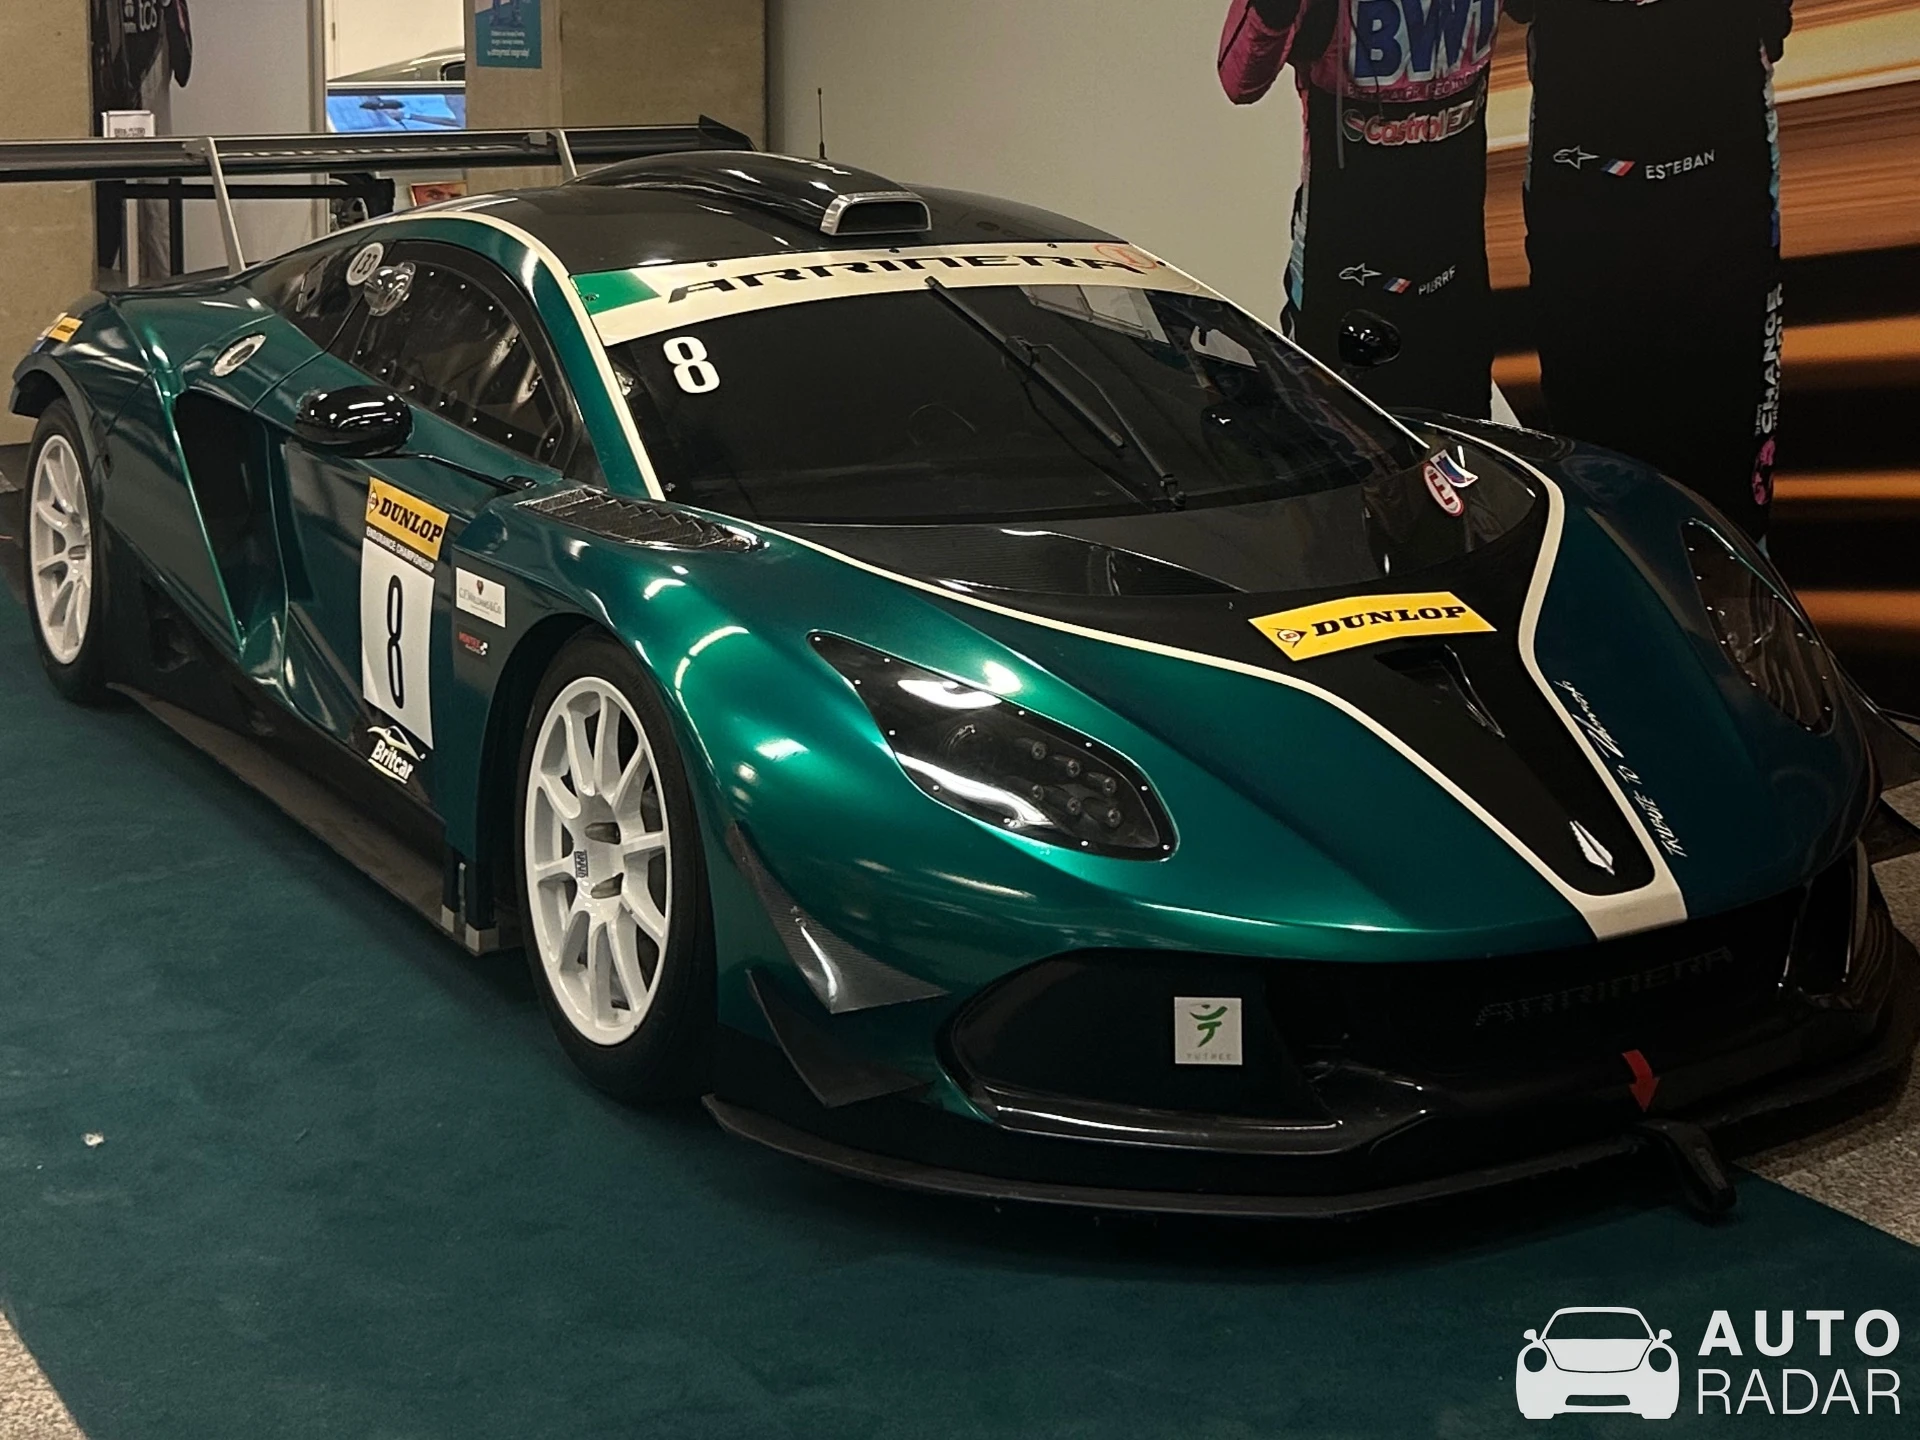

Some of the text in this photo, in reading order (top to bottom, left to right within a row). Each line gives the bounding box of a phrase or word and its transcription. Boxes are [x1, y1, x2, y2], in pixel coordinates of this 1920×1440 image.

[1364, 110, 1448, 146] Castrol
[1645, 148, 1715, 180] ESTEBAN
[667, 253, 1148, 304] ARRINERA
[663, 336, 720, 394] 8
[378, 497, 443, 543] DUNLOP
[387, 575, 404, 709] 8
[1311, 605, 1467, 637] DUNLOP
[370, 739, 414, 780] Britcar
